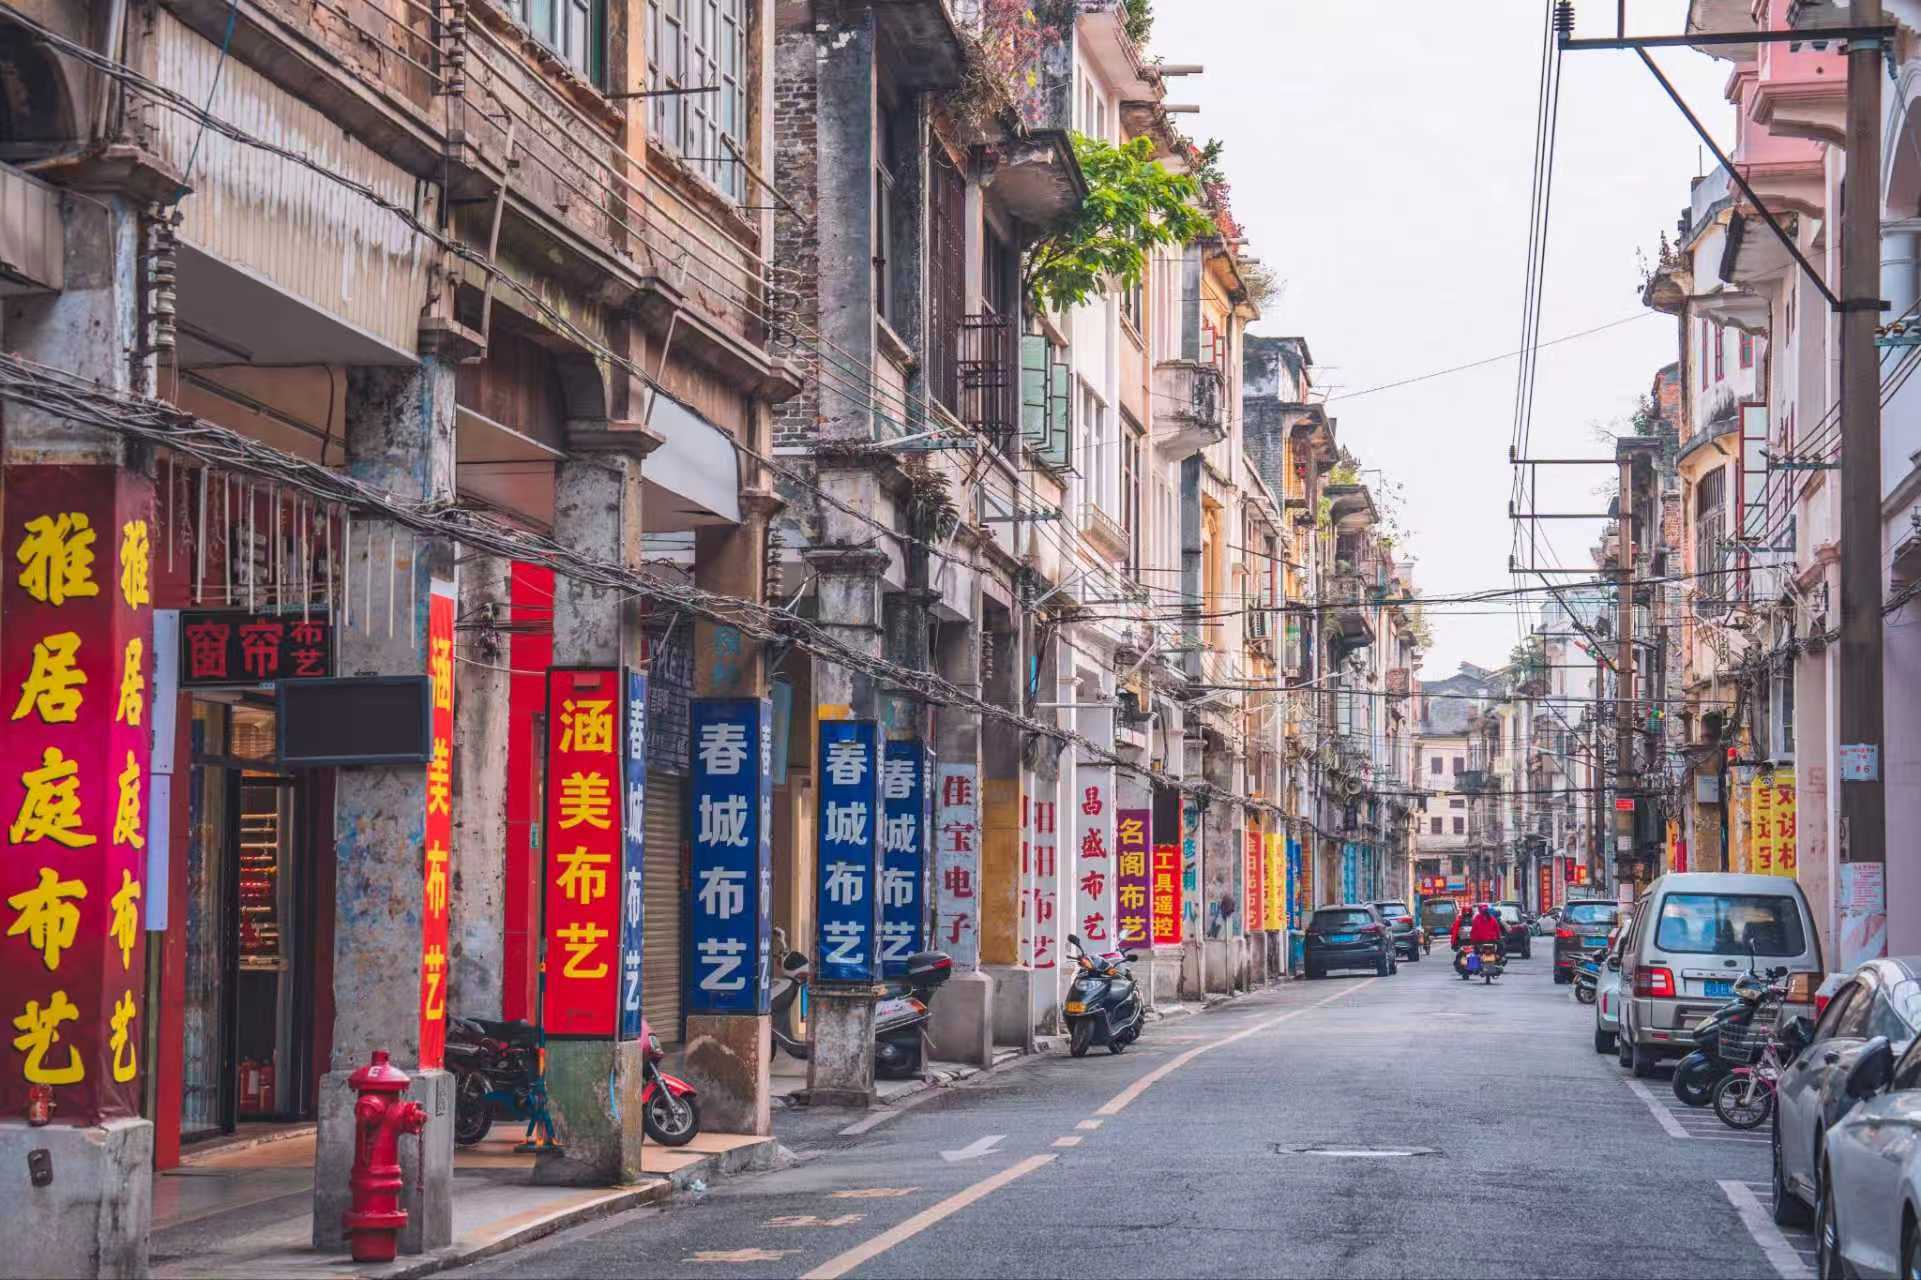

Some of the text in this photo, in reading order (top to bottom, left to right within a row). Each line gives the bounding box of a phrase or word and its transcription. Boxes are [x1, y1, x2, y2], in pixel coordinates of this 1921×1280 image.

[6, 513, 100, 1085] 雅居庭布艺
[110, 520, 149, 1084] 雅居庭布艺
[423, 636, 452, 1020] 涵美布艺
[556, 698, 614, 980] 涵美布艺
[626, 698, 644, 1011] 春城布艺
[697, 722, 750, 992] 春城布艺
[823, 739, 868, 965] 春城布艺
[881, 760, 917, 962] 春城布艺
[942, 774, 976, 945] 佳宝电子
[1081, 785, 1107, 941] 昌盛布艺
[1119, 817, 1147, 942] 名阁布艺
